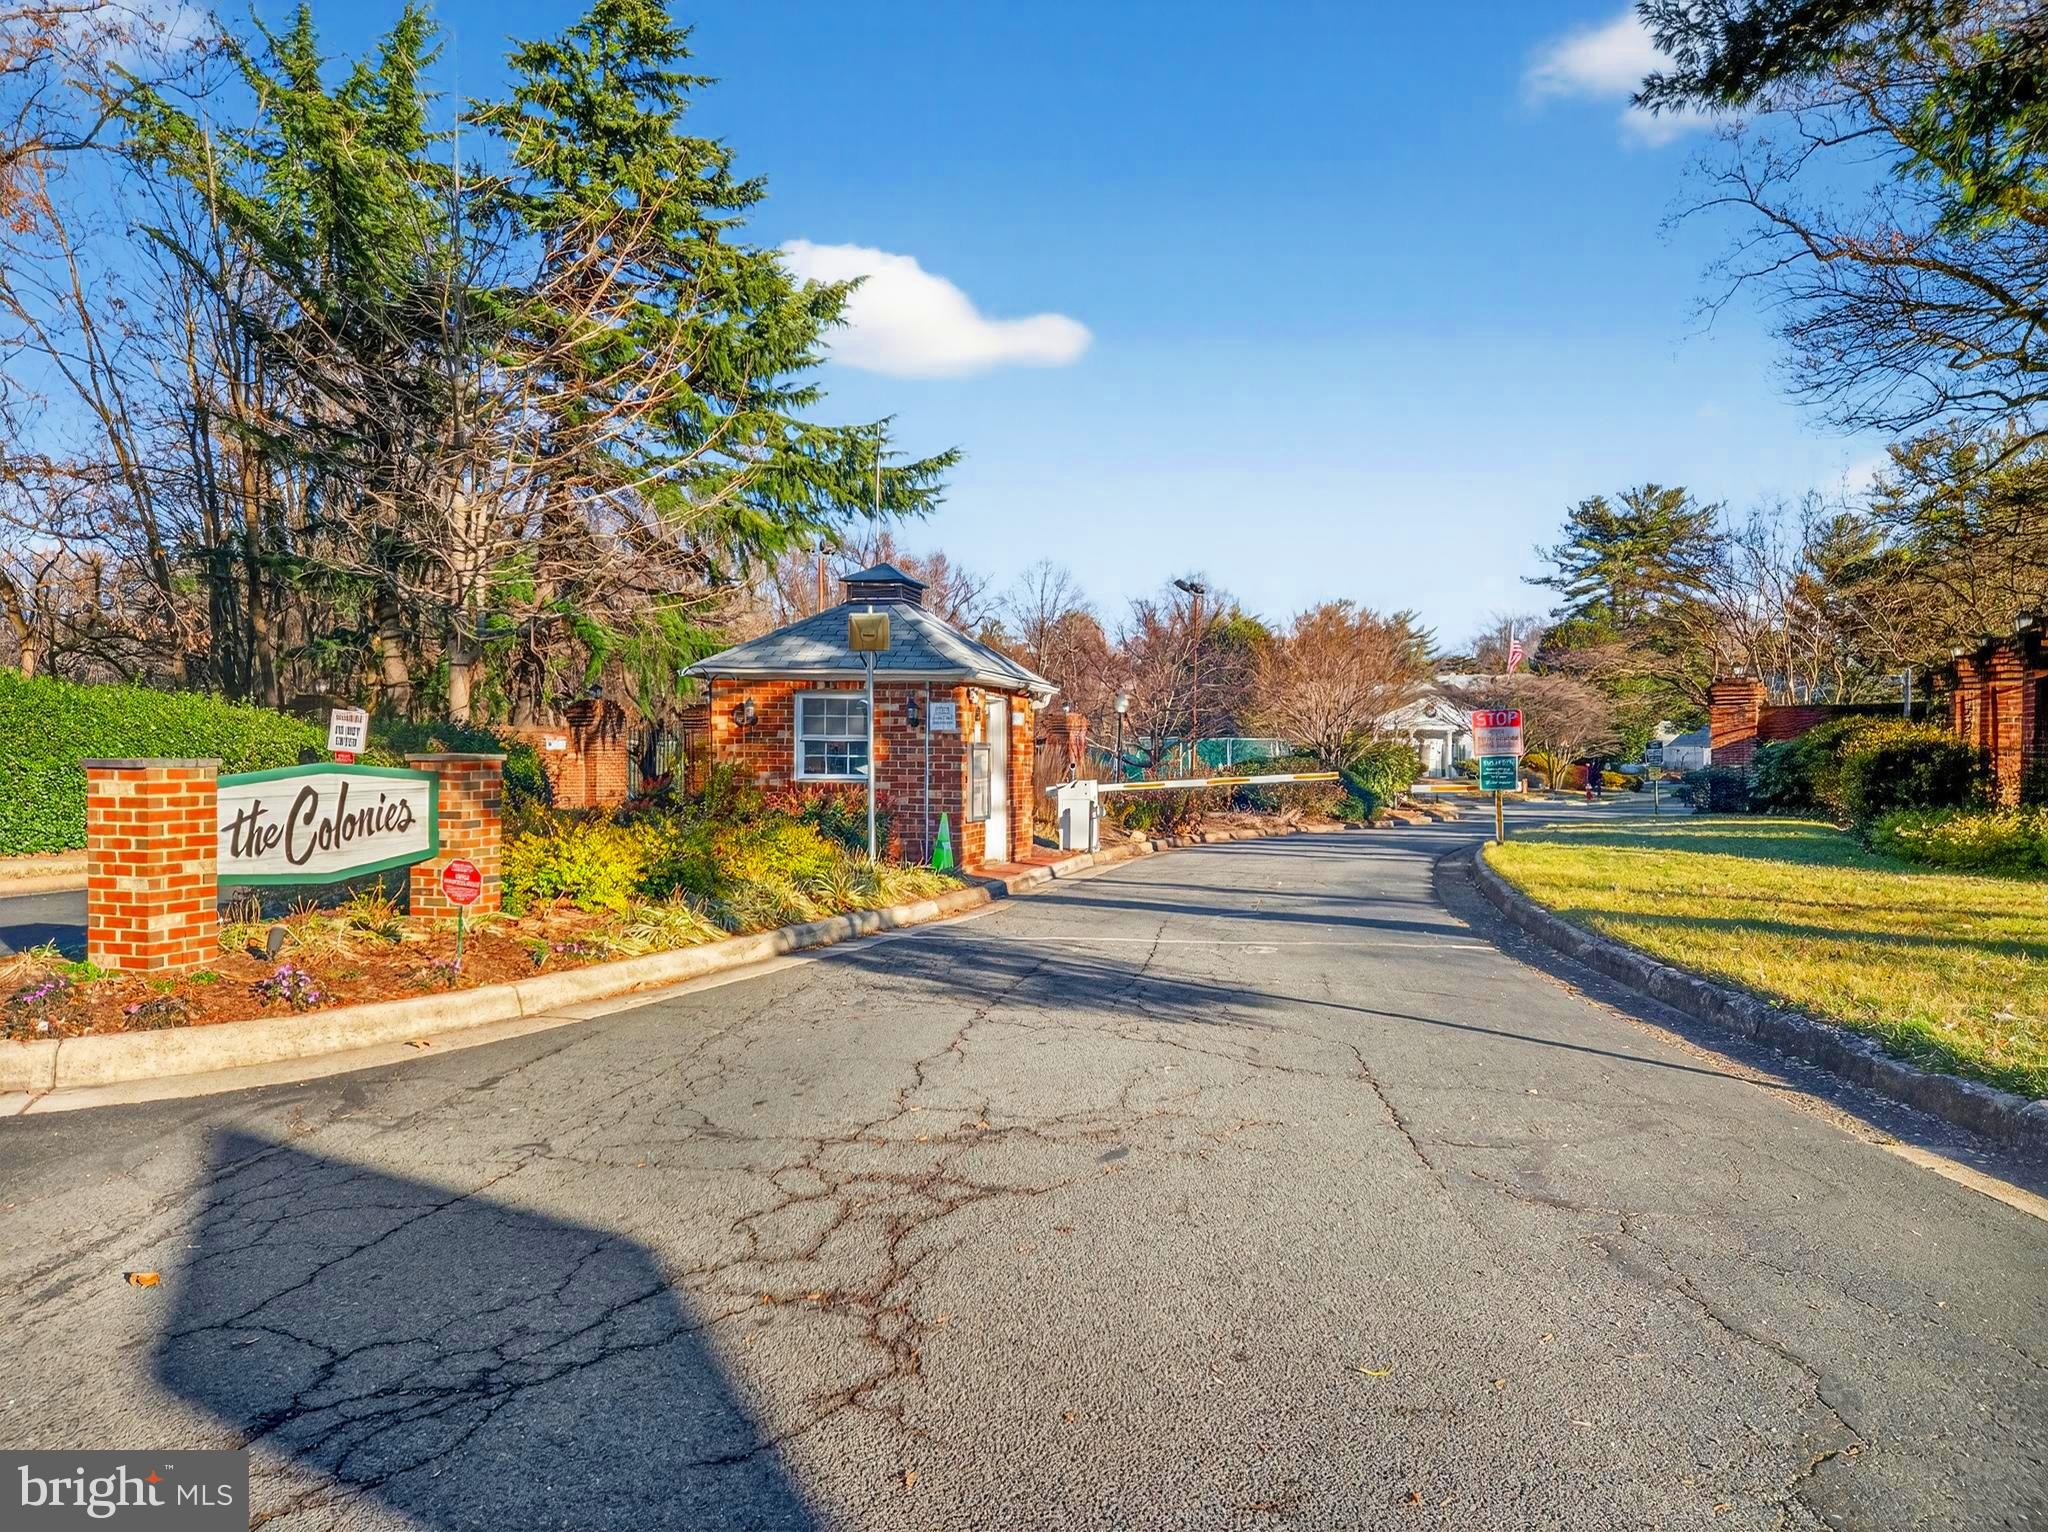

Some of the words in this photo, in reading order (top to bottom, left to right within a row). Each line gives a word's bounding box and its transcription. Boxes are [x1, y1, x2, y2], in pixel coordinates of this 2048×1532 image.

[1476, 711, 1518, 726] STOP
[220, 799, 285, 858] the
[285, 781, 416, 866] Colonies
